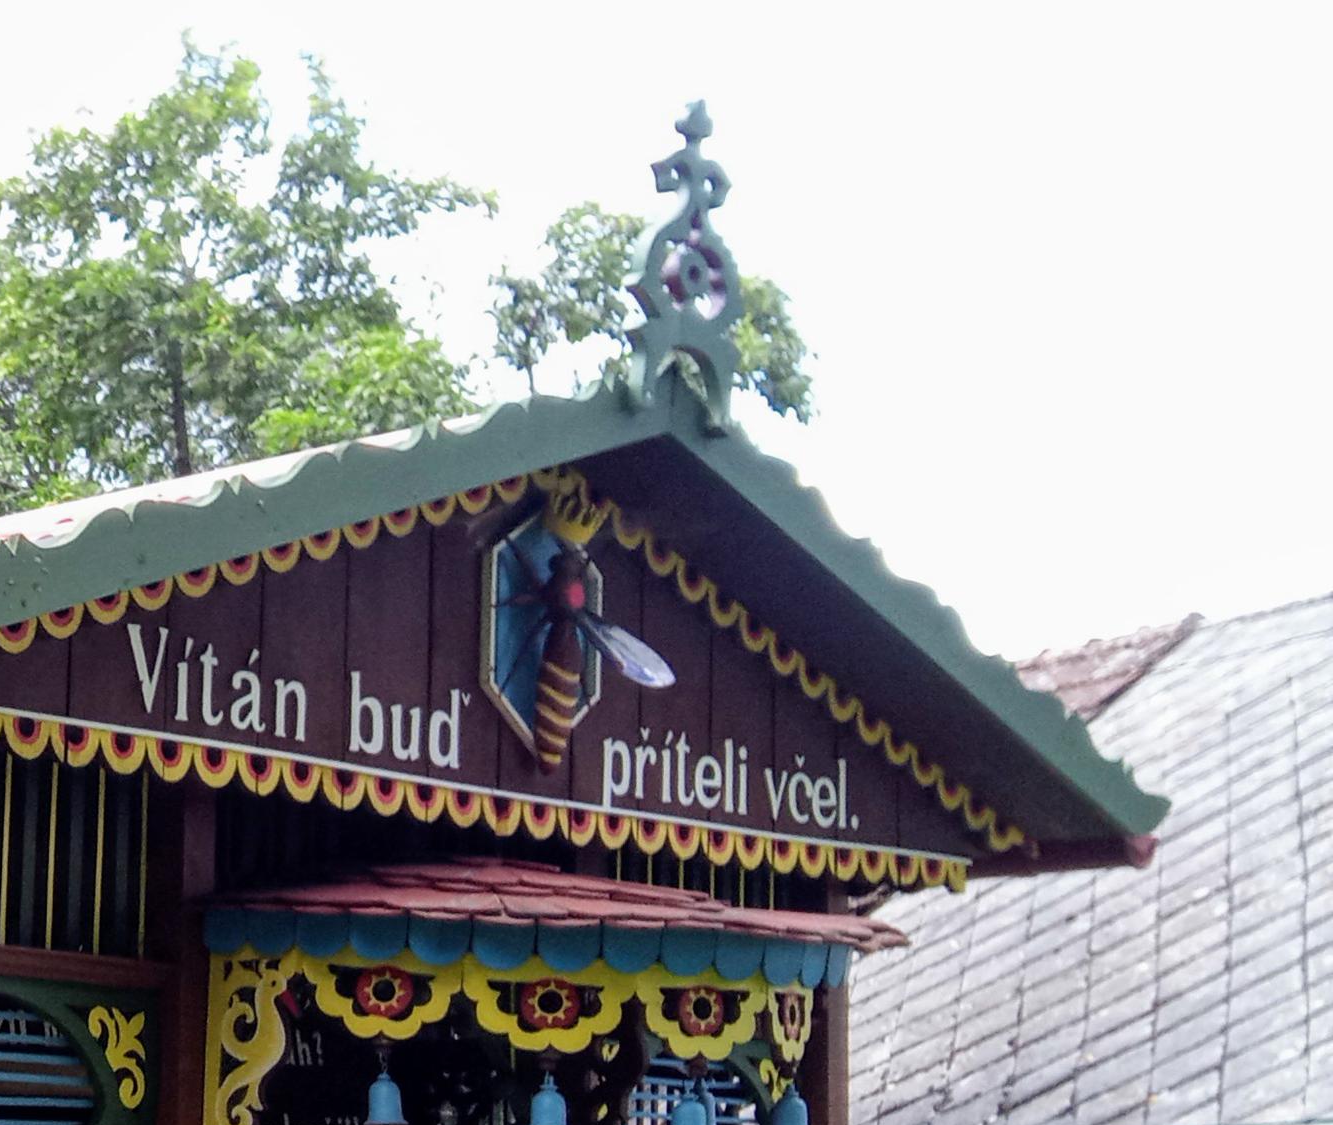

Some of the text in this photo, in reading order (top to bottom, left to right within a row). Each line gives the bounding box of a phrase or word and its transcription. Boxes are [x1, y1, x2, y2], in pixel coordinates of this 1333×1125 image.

[127, 623, 860, 831] Vítán buď příteli včel.
